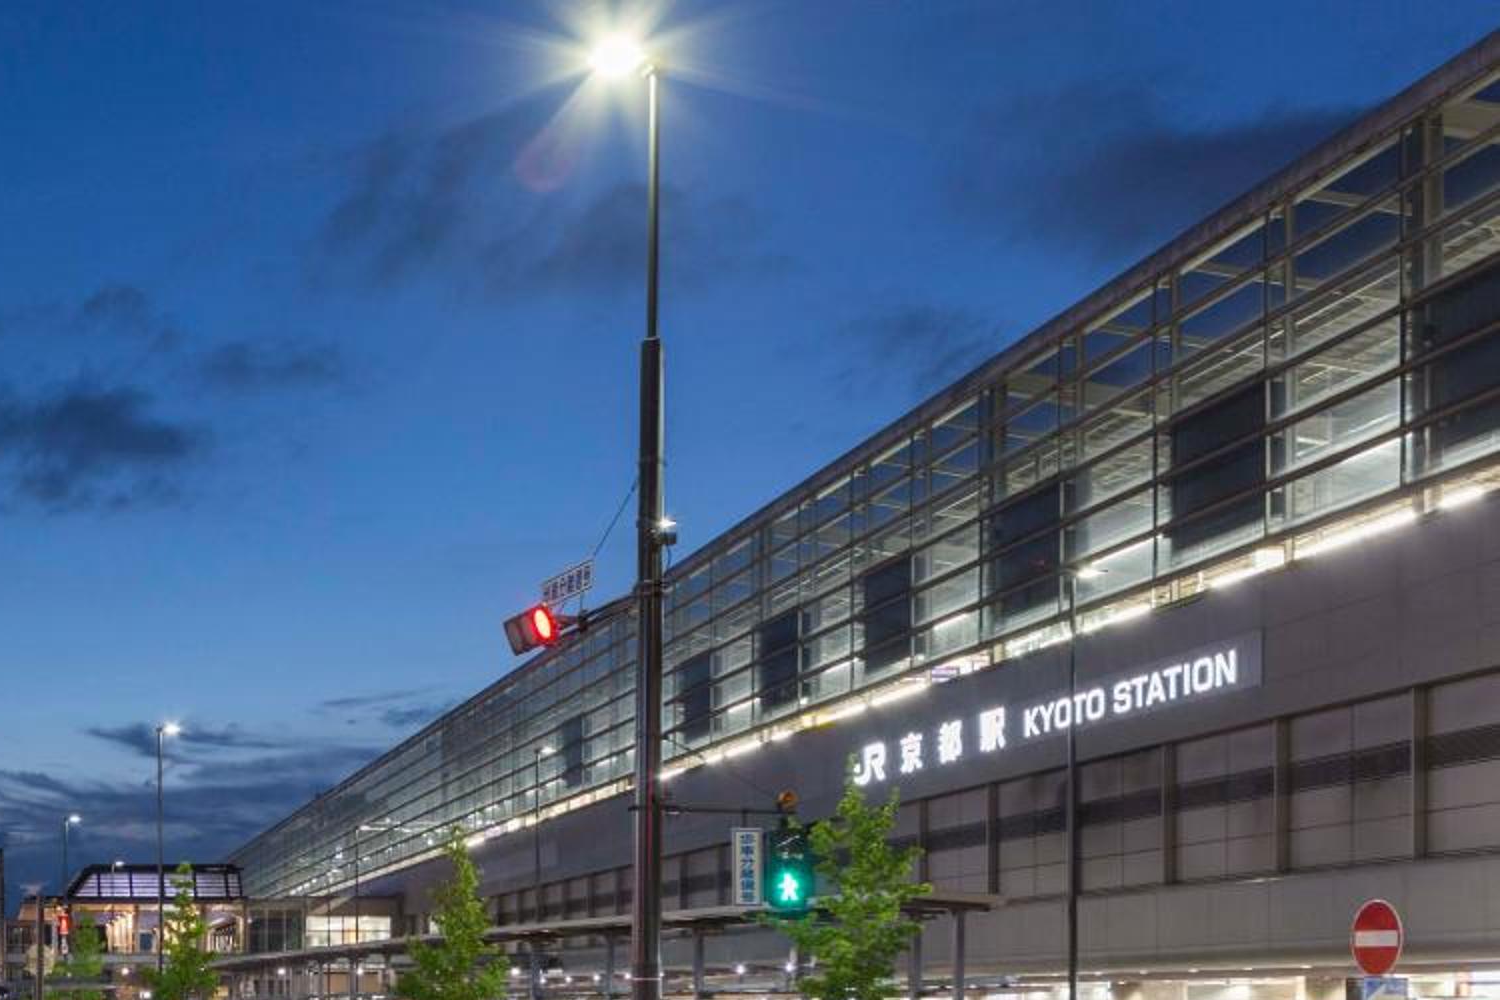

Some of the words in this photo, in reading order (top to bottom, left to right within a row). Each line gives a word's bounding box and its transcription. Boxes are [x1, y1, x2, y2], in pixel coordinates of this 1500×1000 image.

[853, 741, 887, 785] JR
[900, 706, 1006, 774] 京都駅
[1023, 687, 1106, 739] KYOTO
[1112, 648, 1238, 714] STATION
